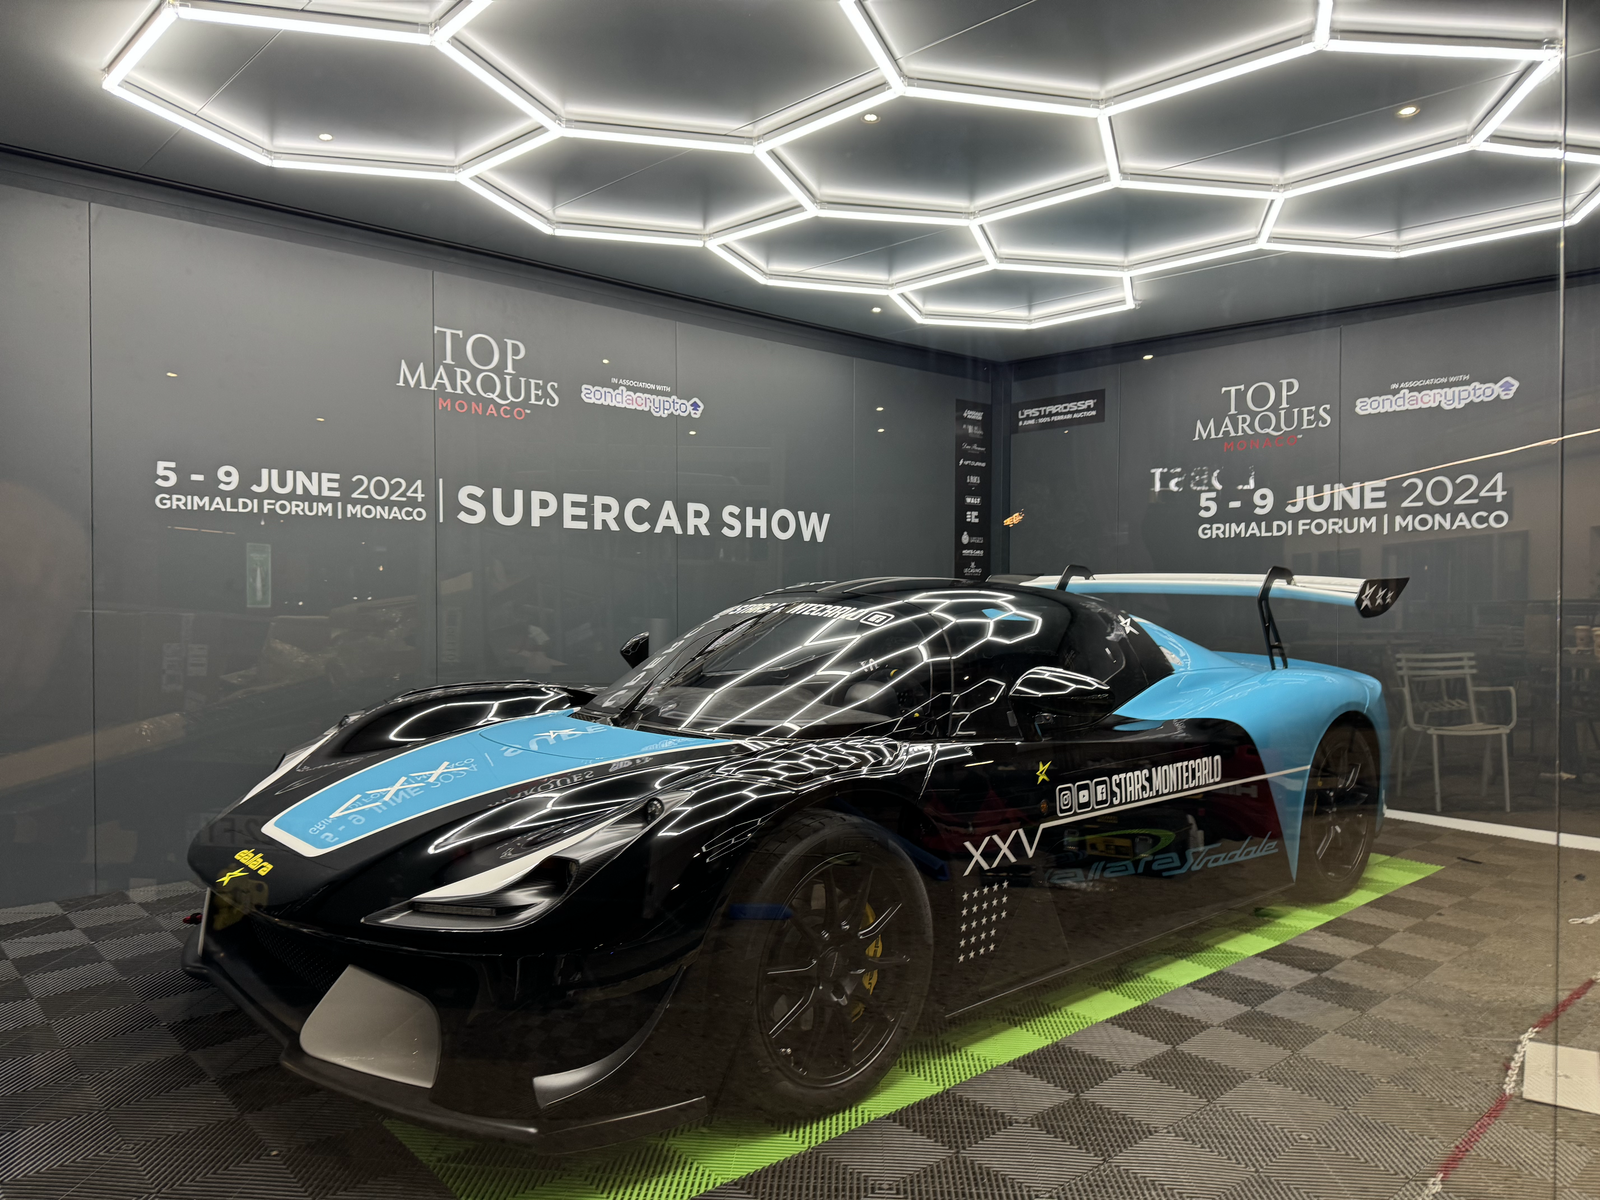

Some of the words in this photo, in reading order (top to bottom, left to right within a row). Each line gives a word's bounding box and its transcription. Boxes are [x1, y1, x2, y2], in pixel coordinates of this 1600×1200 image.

[434, 326, 526, 374] TOP
[396, 359, 560, 407] MARQUES
[619, 379, 656, 389] ASSOCIATION
[656, 384, 671, 392] WITH
[1221, 378, 1300, 415] TOP
[1400, 377, 1448, 388] ASSOCIATION
[1449, 374, 1470, 383] WITH
[438, 397, 525, 420] MONACO
[582, 385, 690, 417] zondacrypto
[1073, 410, 1097, 419] AUCTION
[1358, 384, 1496, 413] zondacrypto
[1192, 404, 1332, 441] MARQUES
[1223, 435, 1298, 452] MONACO
[155, 460, 178, 488] 5
[217, 465, 239, 491] 9
[250, 468, 341, 497] JUNE
[350, 474, 426, 502] 2024
[1198, 491, 1218, 518] 5
[1252, 487, 1275, 515] 9
[1284, 480, 1388, 514] JUNE
[1400, 472, 1508, 508] 2024
[154, 493, 259, 513] GRIMALDI
[263, 499, 333, 517] FORUM
[346, 504, 427, 521] MONACO
[456, 485, 711, 536] SUPERCAR
[720, 504, 831, 543] SHOW
[1197, 522, 1293, 540] GRIMALDI
[1297, 516, 1377, 537] FORUM
[1394, 510, 1509, 534] MONACO
[1111, 754, 1222, 805] STARS.MONTECARLO
